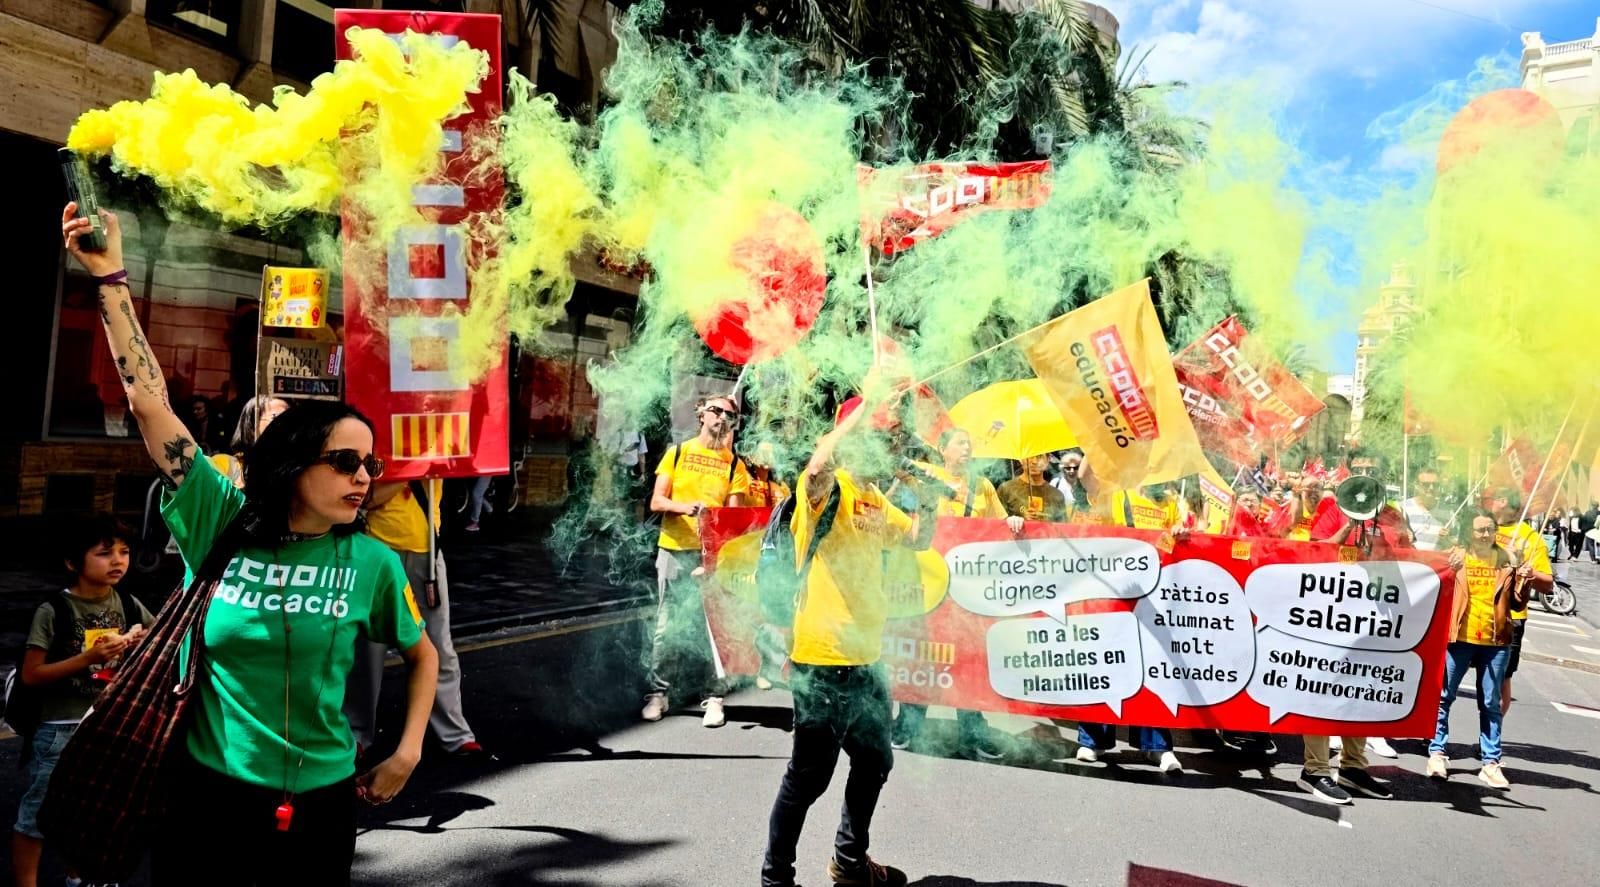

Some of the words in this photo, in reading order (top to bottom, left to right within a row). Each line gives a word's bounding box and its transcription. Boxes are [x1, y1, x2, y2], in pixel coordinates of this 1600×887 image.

[1096, 332, 1143, 410] CCOO
[1205, 332, 1273, 401] CCOO
[1070, 342, 1136, 448] educació
[954, 553, 1150, 576] infraestructures
[983, 580, 1058, 607] dignes
[1160, 582, 1230, 605] ràtios
[1298, 570, 1401, 604] pujada
[1153, 609, 1235, 631] alumnat
[1287, 604, 1405, 639] salarial
[1026, 629, 1049, 644] no
[1055, 628, 1067, 643] a
[1073, 624, 1100, 642] les
[1170, 637, 1215, 655] molt
[1003, 648, 1098, 669] retallades
[1104, 649, 1126, 665] en
[1268, 649, 1406, 685] sobrecàrrega
[1023, 673, 1111, 696] plantilles
[1147, 661, 1239, 683] elevades
[1262, 669, 1288, 687] de
[1295, 673, 1405, 705] burocràcia
